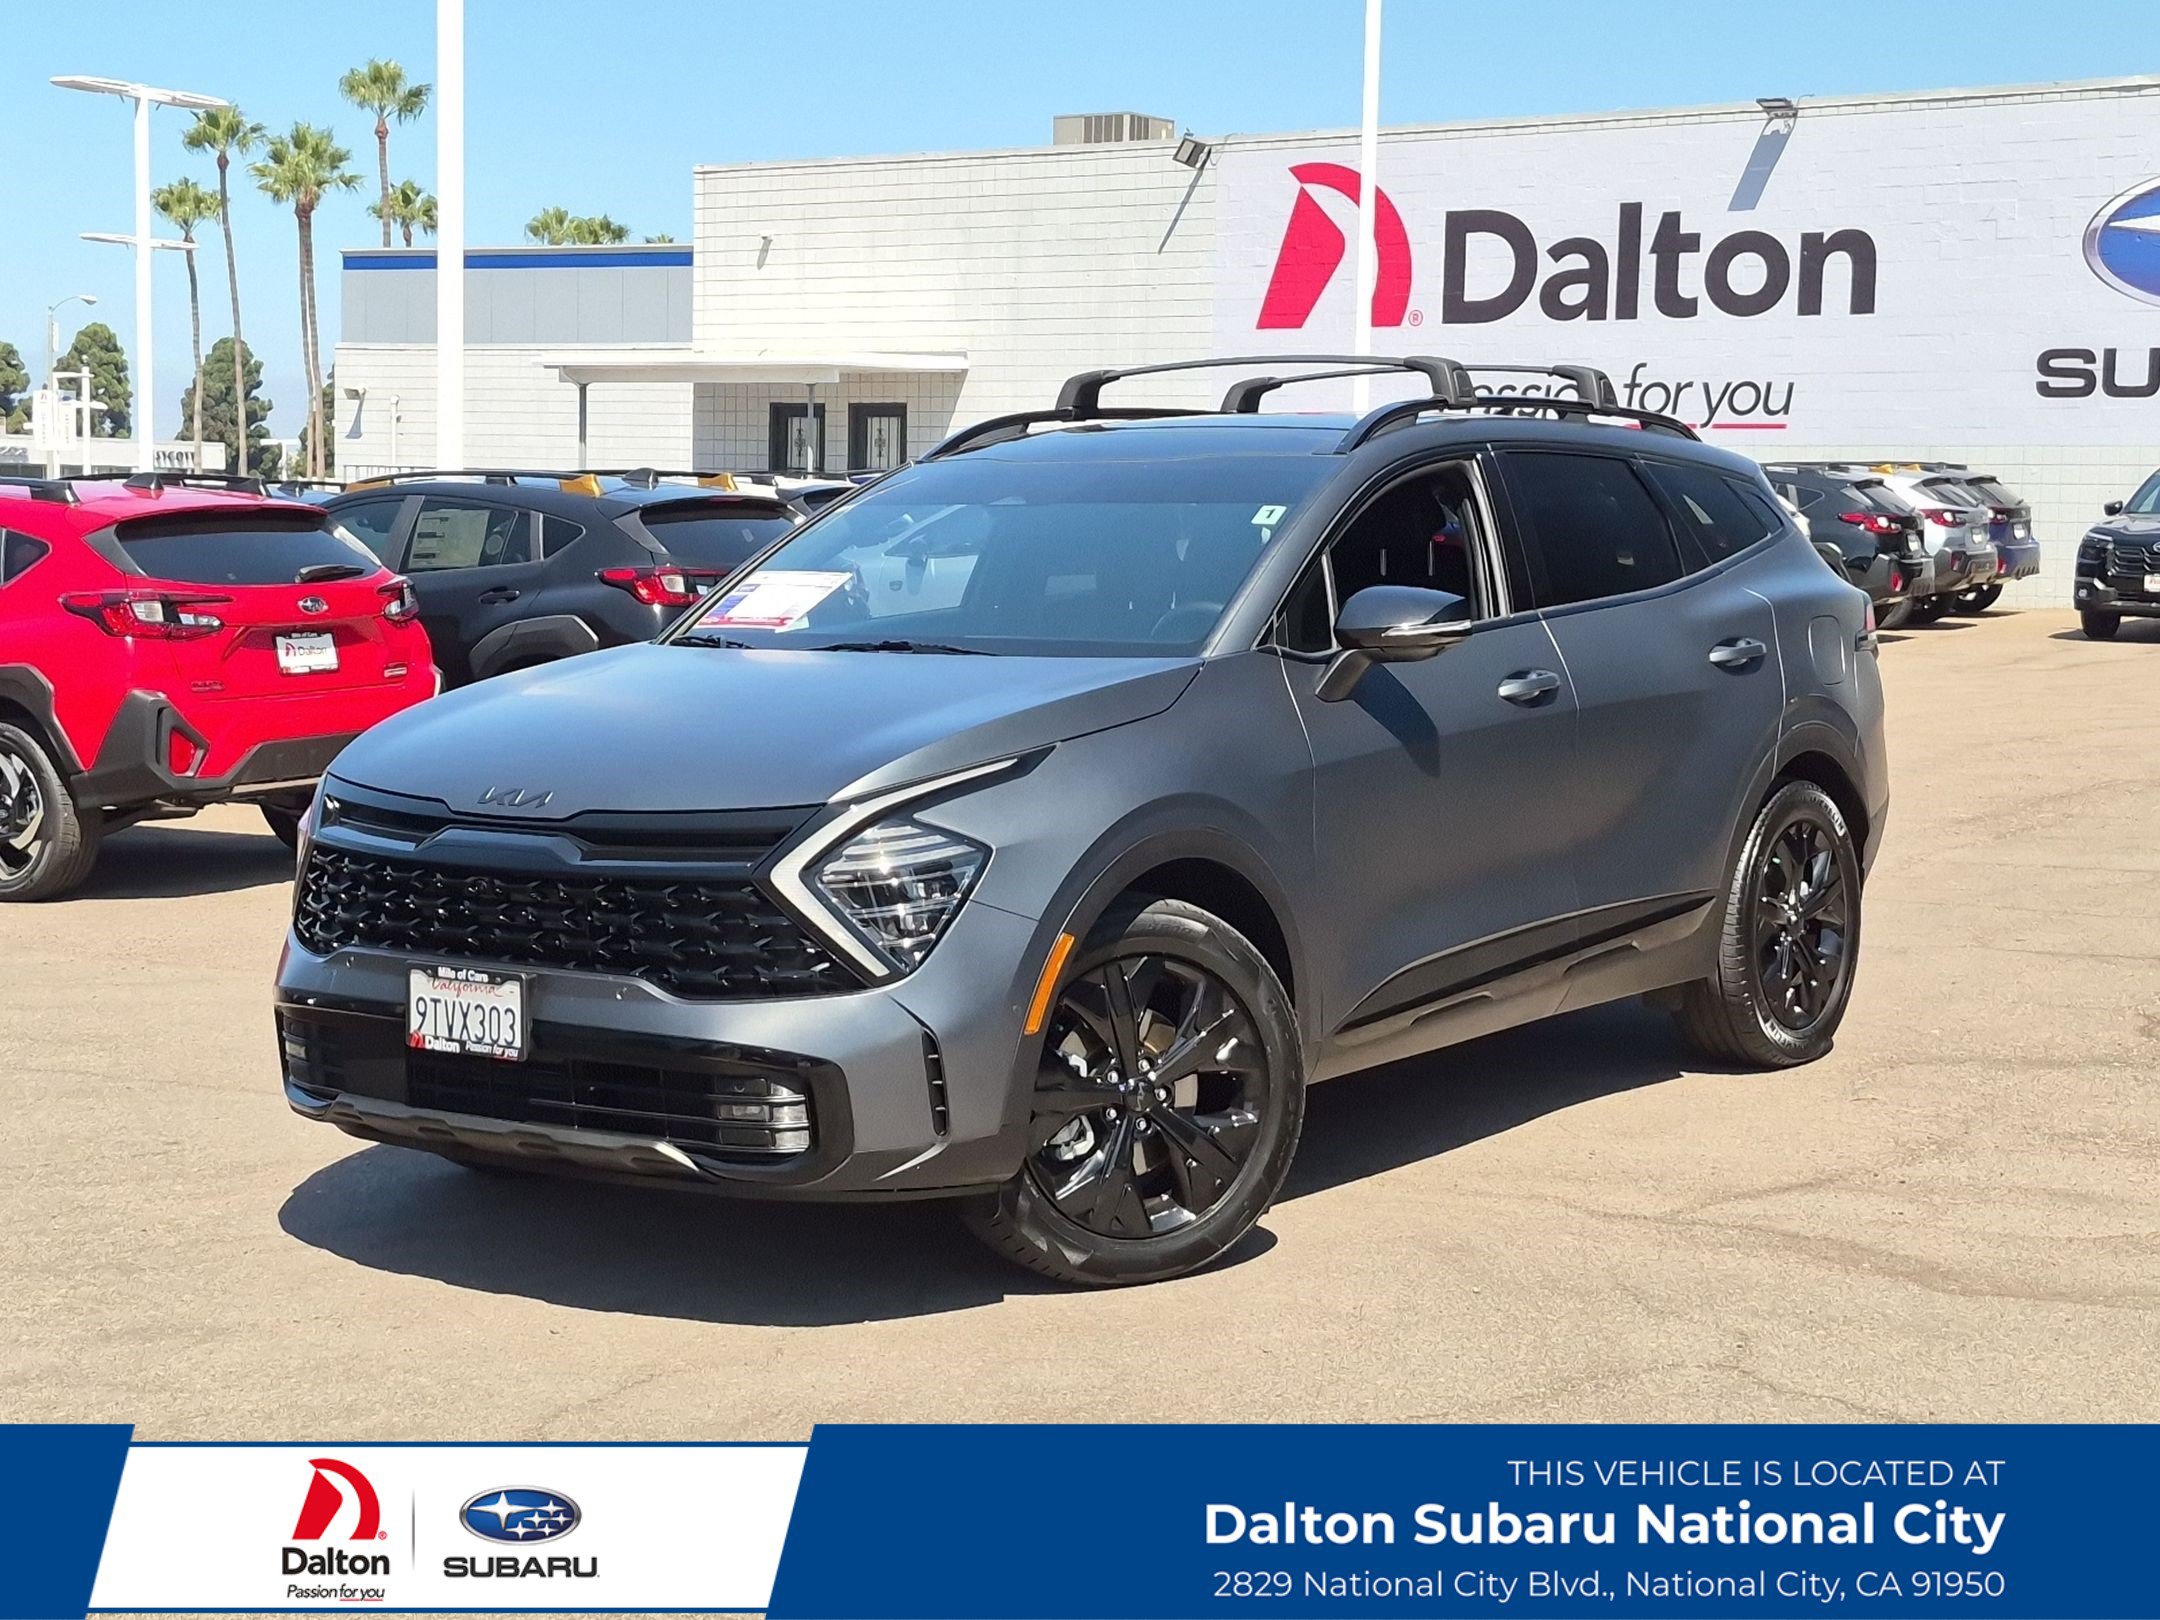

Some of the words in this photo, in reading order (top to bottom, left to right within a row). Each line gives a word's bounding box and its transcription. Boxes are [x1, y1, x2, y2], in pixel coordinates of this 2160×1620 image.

[1443, 203, 1876, 323] Dalton
[1623, 362, 1693, 415] for
[1700, 381, 1794, 428] you
[431, 977, 504, 998] California
[457, 969, 467, 980] of
[468, 970, 489, 983] Cars
[416, 996, 516, 1046] 9TVX303
[425, 1035, 460, 1053] Dalton
[465, 1040, 492, 1054] Passion
[493, 1044, 504, 1056] for
[504, 1048, 519, 1059] you
